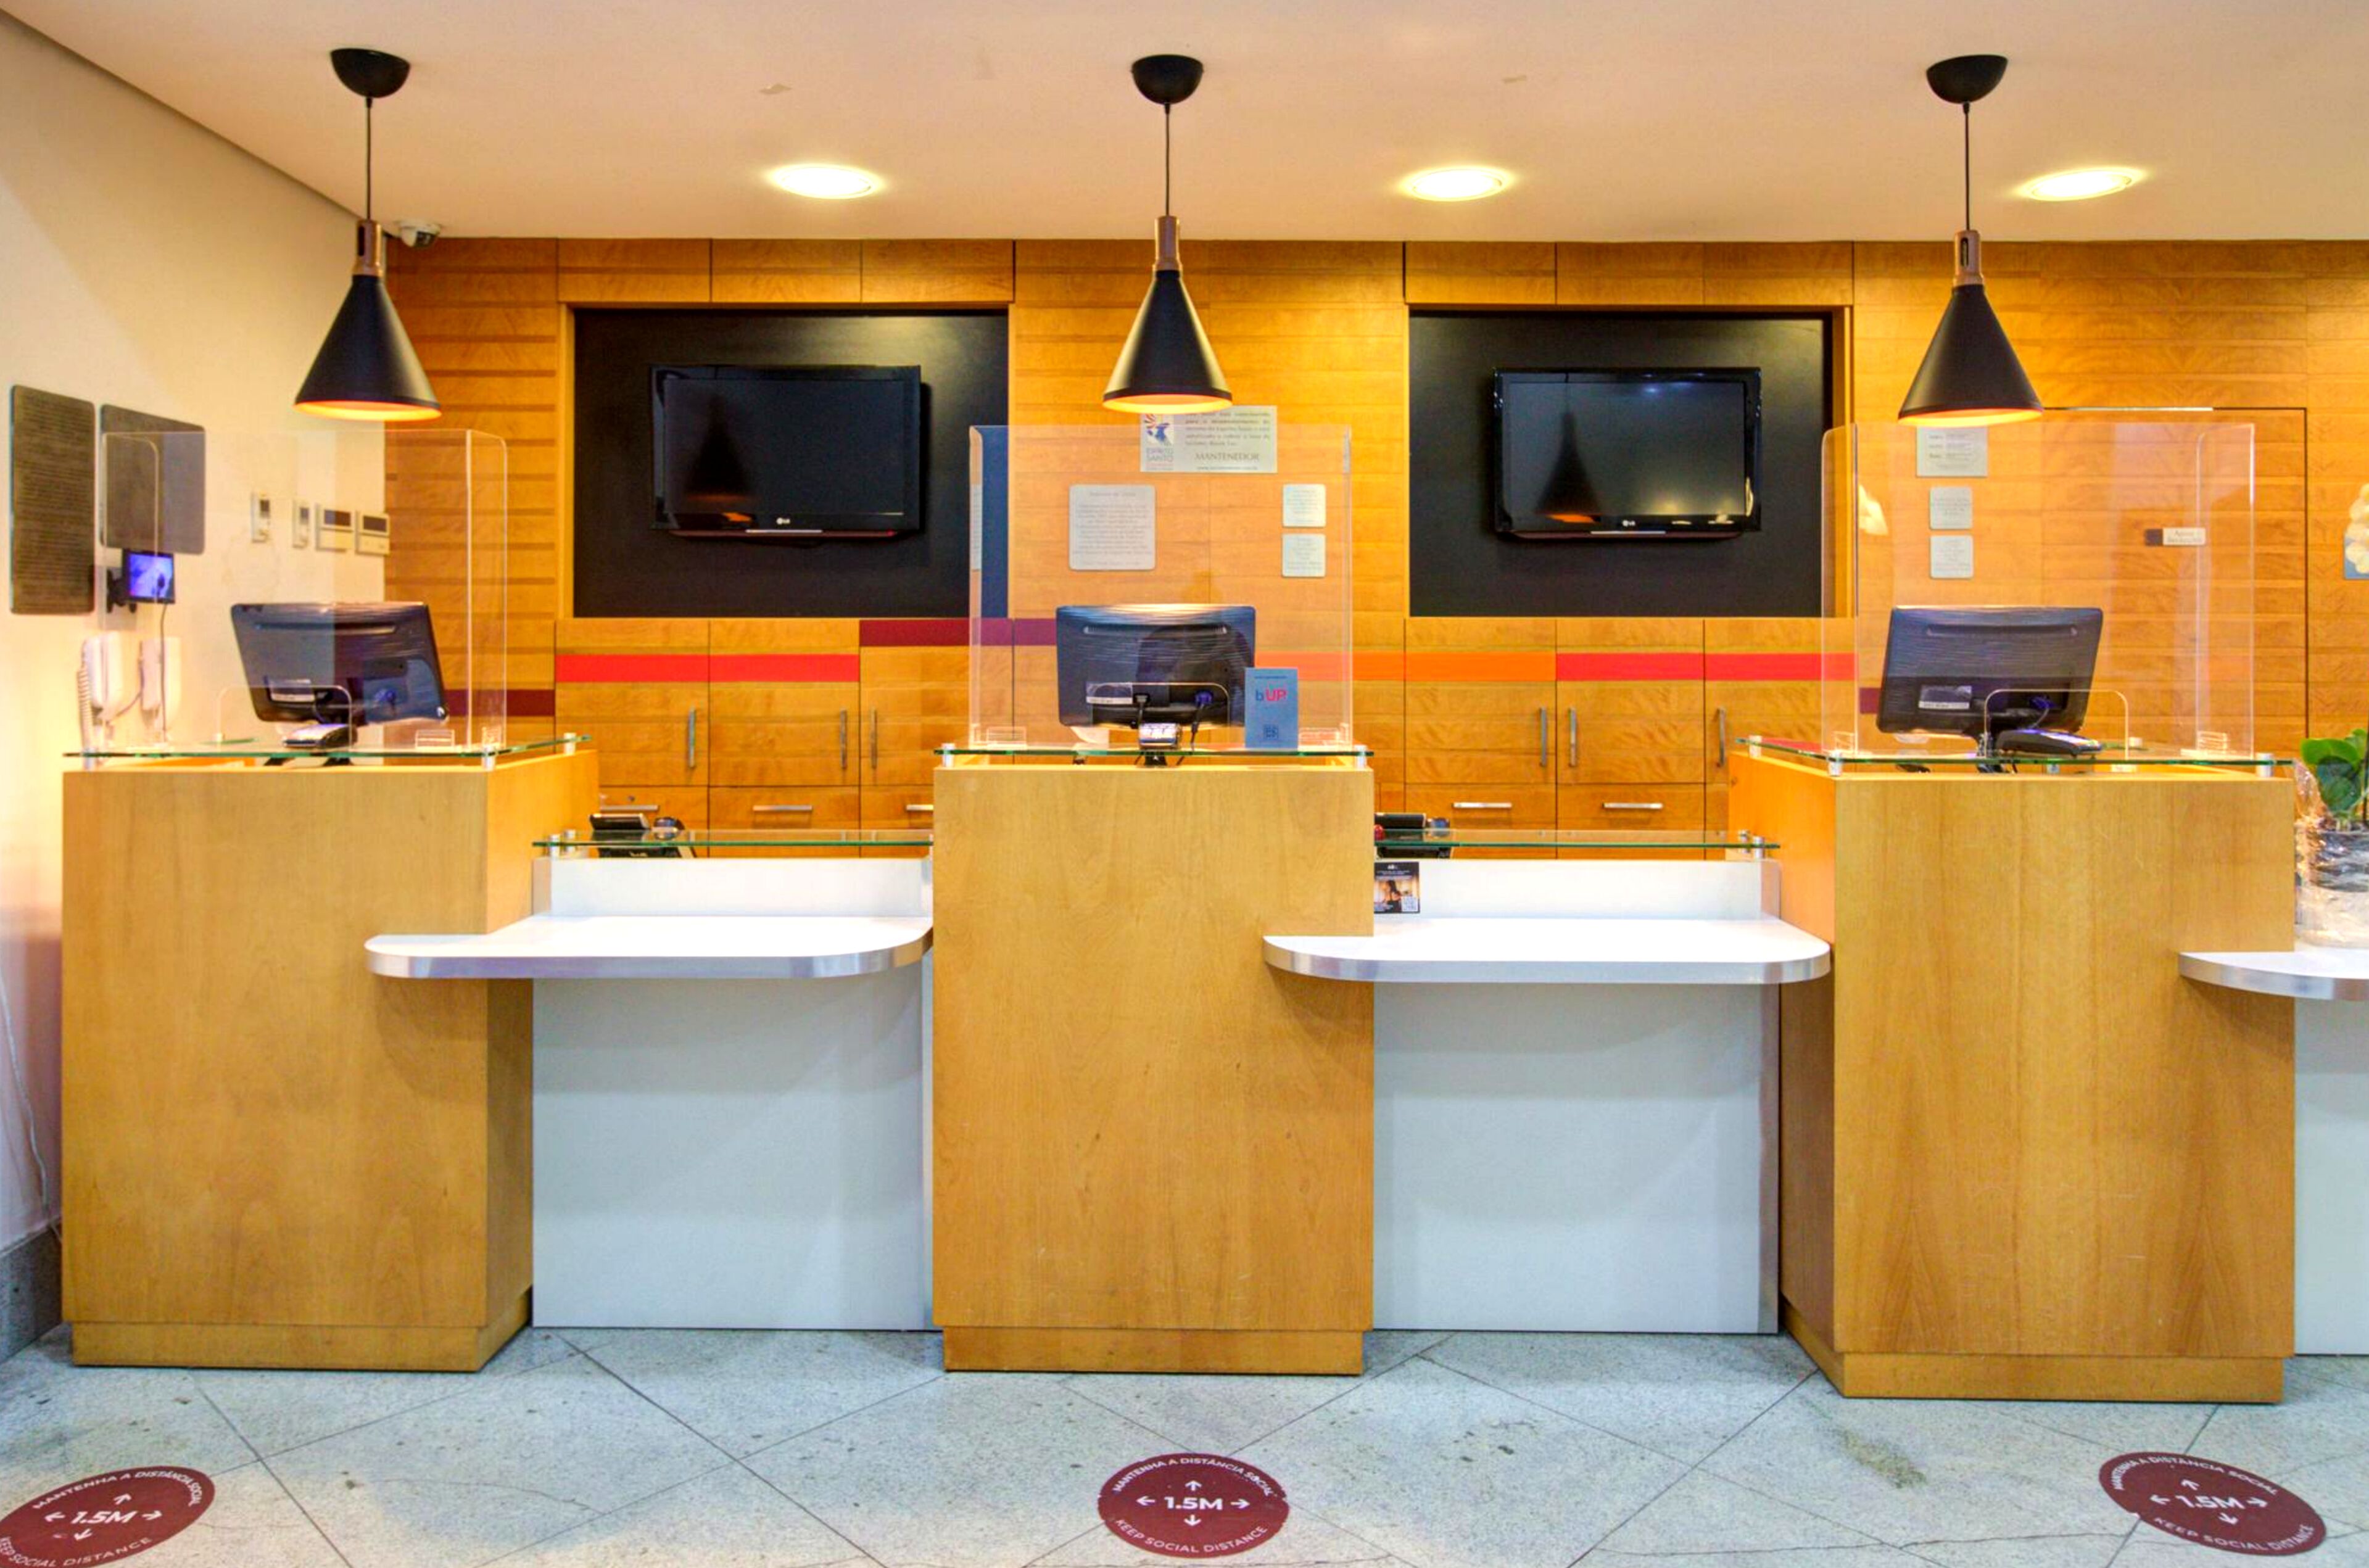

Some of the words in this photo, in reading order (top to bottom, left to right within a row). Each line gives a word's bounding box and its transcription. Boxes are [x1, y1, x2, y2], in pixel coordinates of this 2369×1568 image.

[32, 1475, 117, 1509] MANTENHA
[1112, 1461, 1166, 1493] MANTENHA
[1243, 1471, 1274, 1496] SOCIAL
[2228, 1471, 2278, 1496] SOCIAL
[1164, 1496, 1223, 1511] 1.5M
[2175, 1495, 2246, 1509] 1.5M
[71, 1511, 138, 1524] 1.5M
[1115, 1519, 1146, 1539] KEEP
[1144, 1537, 1200, 1553] SOCIAL
[1203, 1525, 1268, 1553] DISTANCE
[2154, 1517, 2199, 1537] KEEP
[2202, 1534, 2269, 1551] SOCIAL
[9, 1553, 57, 1567] SOCIAL
[63, 1537, 153, 1567] DISTANCE
